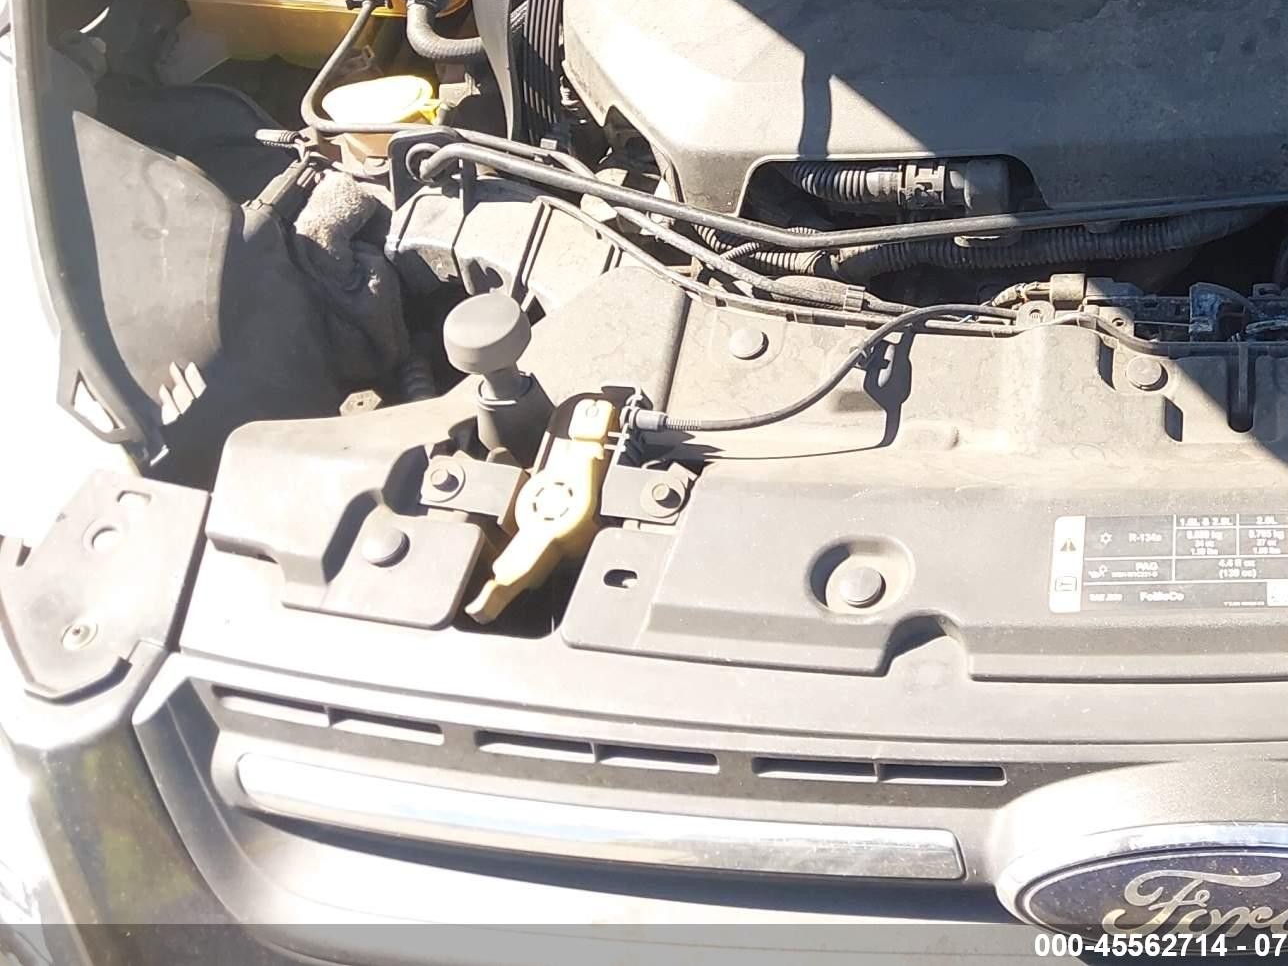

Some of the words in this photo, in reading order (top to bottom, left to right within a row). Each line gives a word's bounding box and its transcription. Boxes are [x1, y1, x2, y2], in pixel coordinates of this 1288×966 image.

[1256, 516, 1278, 525] 2.0L
[1128, 532, 1162, 542] R-134a
[1273, 529, 1285, 540] kg
